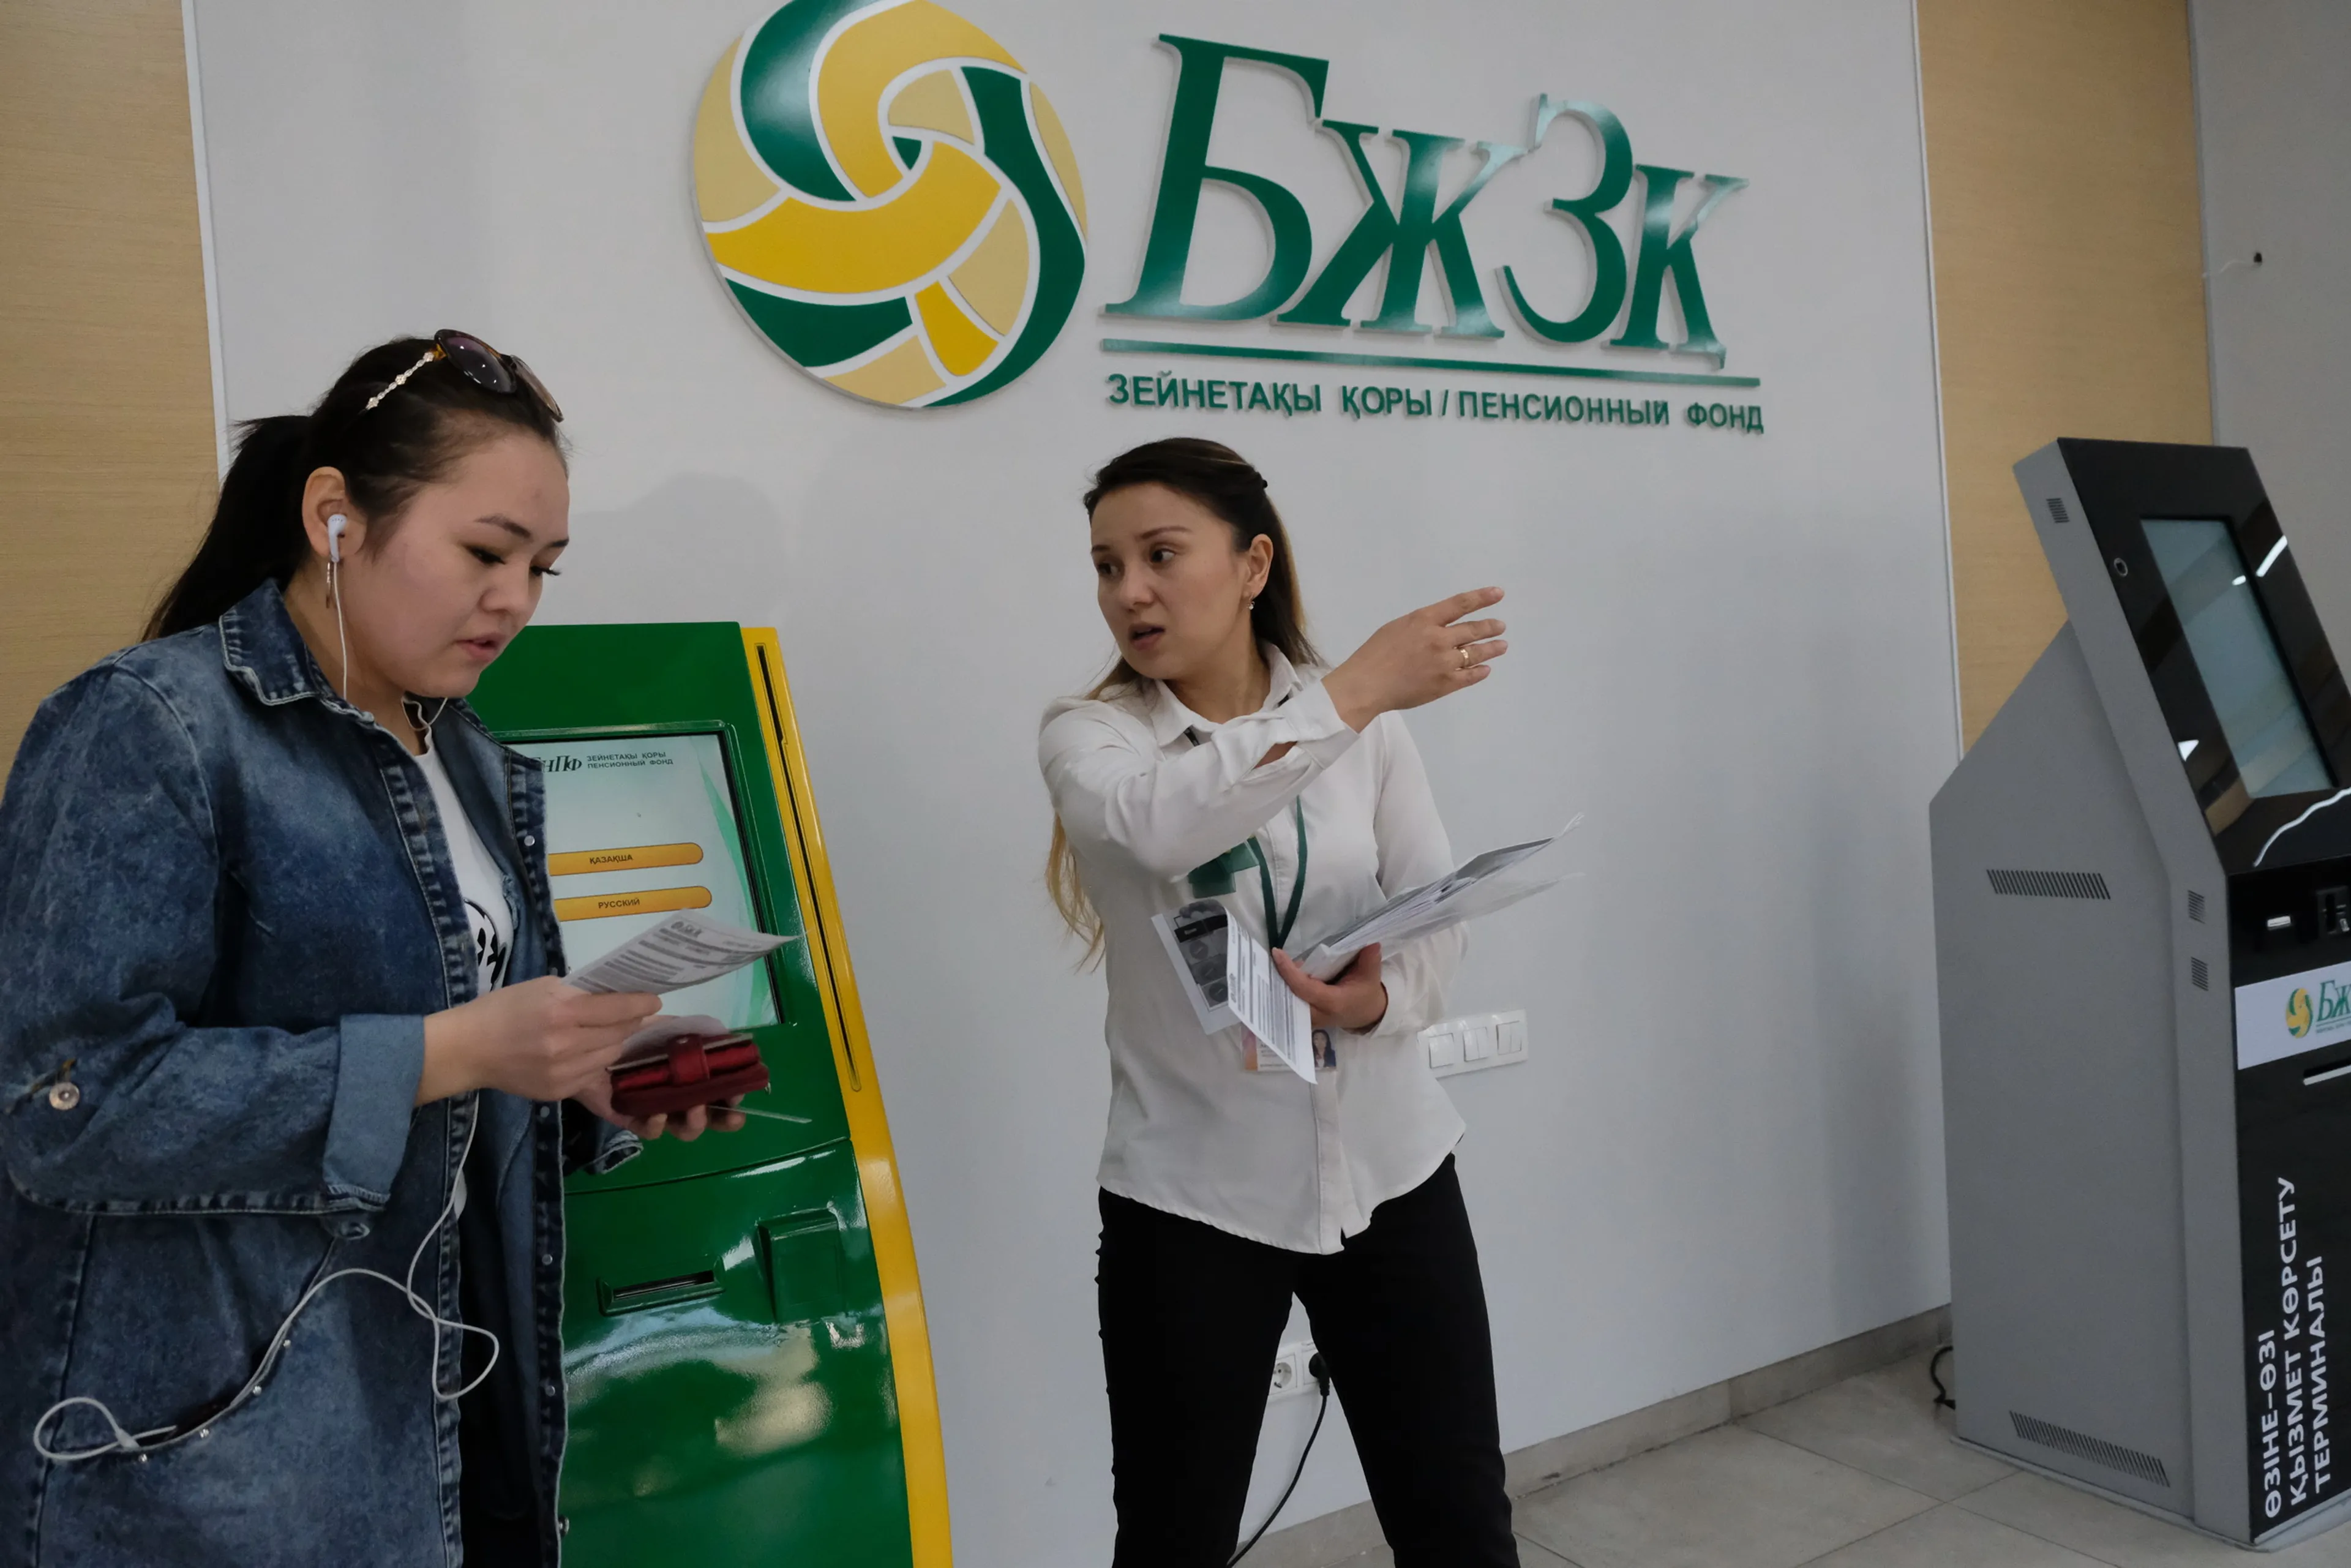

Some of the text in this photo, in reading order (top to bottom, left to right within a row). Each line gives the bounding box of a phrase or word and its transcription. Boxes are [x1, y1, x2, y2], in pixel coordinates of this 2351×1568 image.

[1108, 370, 1322, 417] ЗЕЙНЕТАҚЫ
[1341, 384, 1433, 419] ҚОРЫ
[1686, 402, 1765, 434] ФОНД
[531, 755, 582, 772] НПФ
[587, 751, 667, 762] ЗЕЙНЕТАҚЫ ҚОРЫ
[587, 760, 646, 769] ПЕНСИОННЫЙ
[589, 853, 633, 865] ҚАЗАҚША
[598, 897, 640, 909] РУССКИЙ
[2277, 1176, 2308, 1506] ҚЫЗМЕТ КӨРСЕТУ
[2306, 1256, 2331, 1494] ТЕРМИНАЛЫ
